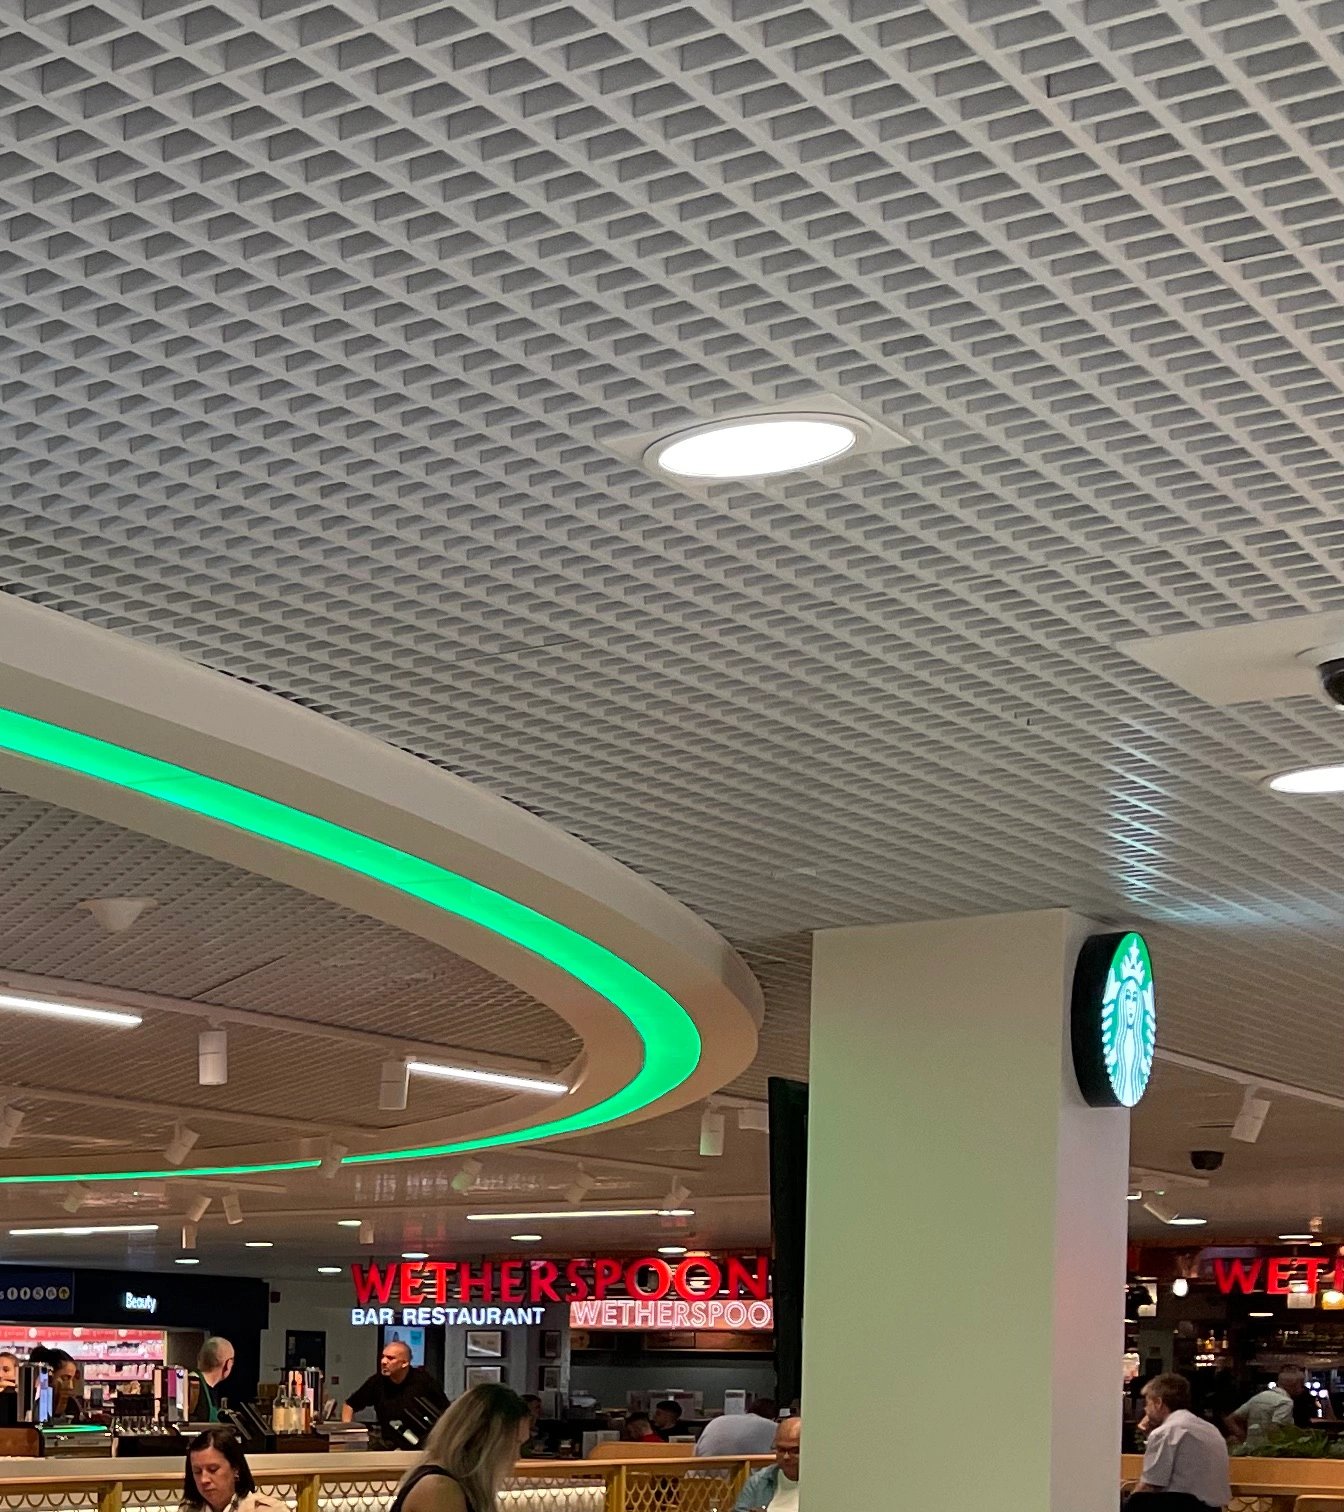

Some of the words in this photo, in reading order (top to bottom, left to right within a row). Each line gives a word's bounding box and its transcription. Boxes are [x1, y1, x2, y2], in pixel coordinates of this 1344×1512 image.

[350, 1255, 769, 1304] WETHERSPOON
[125, 1291, 156, 1313] Beauty
[351, 1307, 394, 1326] BAR
[402, 1306, 546, 1326] RESTAURANT
